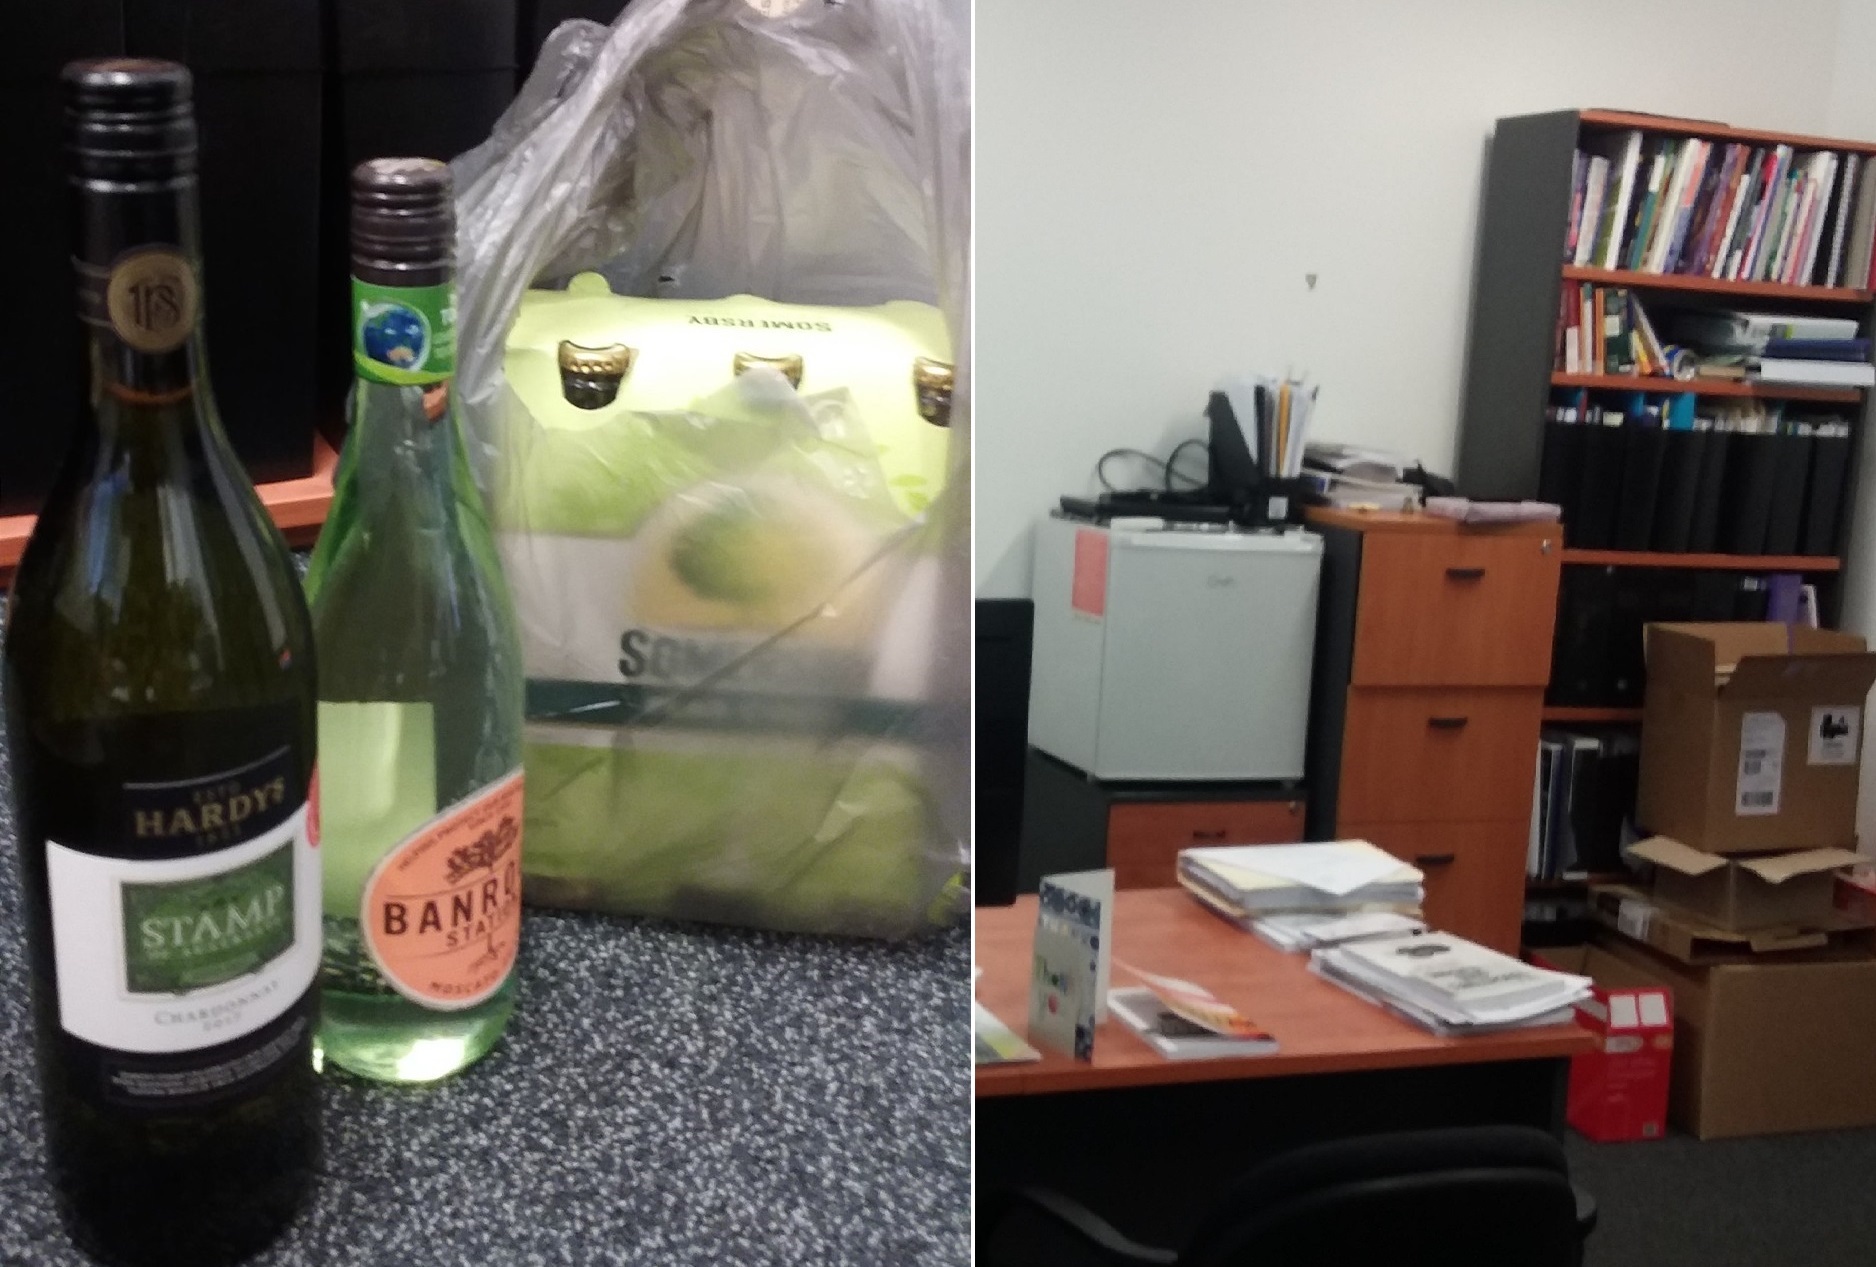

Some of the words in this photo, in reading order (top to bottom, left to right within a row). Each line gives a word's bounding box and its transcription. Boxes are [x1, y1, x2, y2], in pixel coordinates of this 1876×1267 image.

[688, 315, 832, 332] SOMERSBY
[135, 776, 285, 838] HARDYS
[140, 883, 284, 950] STAMP
